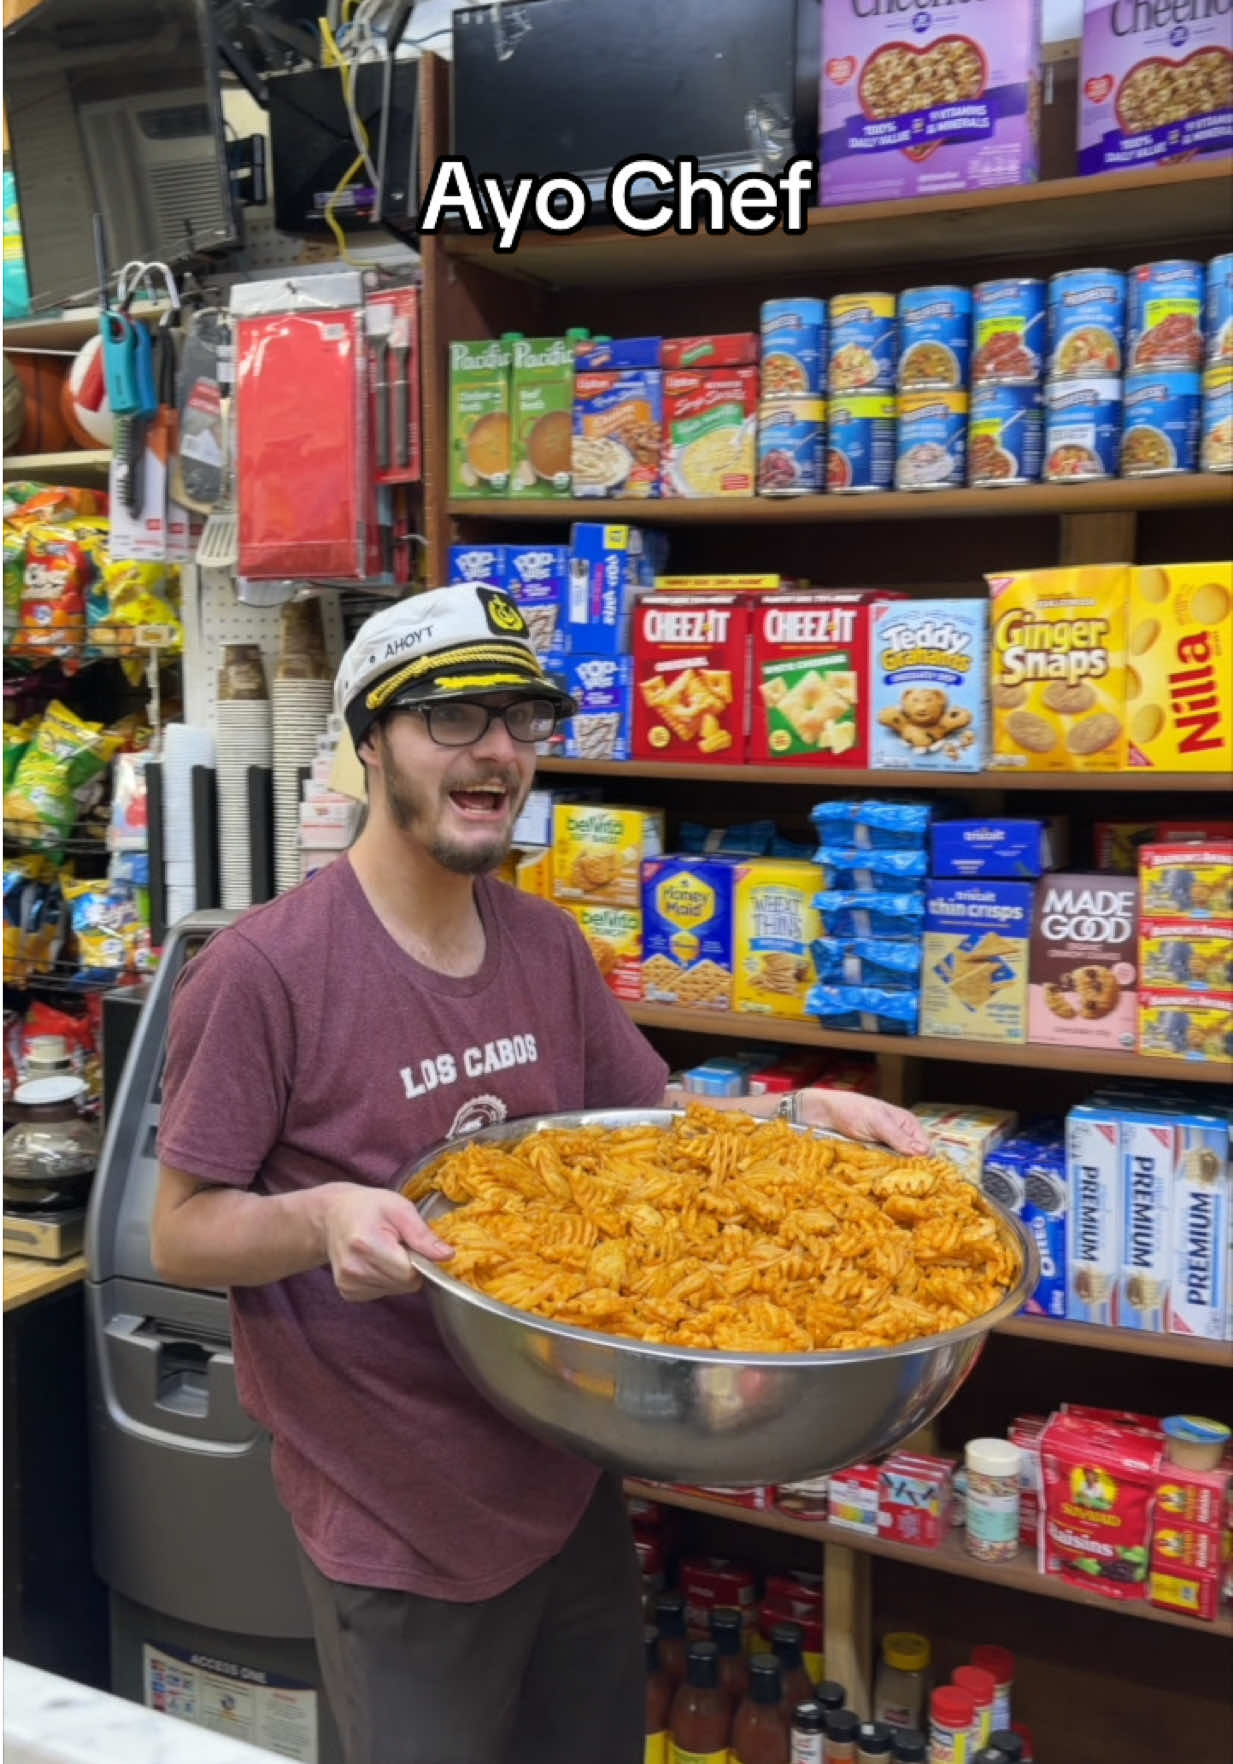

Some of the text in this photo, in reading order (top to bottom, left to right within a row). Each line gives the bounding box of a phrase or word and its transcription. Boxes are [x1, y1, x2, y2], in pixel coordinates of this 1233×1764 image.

[882, 622, 972, 653] Teddy
[996, 608, 1109, 652] Ginger
[1000, 646, 1108, 687] Snaps
[1168, 631, 1225, 753] Nilla
[928, 897, 1024, 924] thin crisps
[1041, 887, 1136, 918] MADE
[1040, 913, 1133, 944] GOOD
[400, 1033, 538, 1100] LOS CABOS
[1081, 1164, 1100, 1263] PREMIUM
[1132, 1154, 1155, 1269] PREMIUM
[1186, 1191, 1212, 1307] PREMIUM
